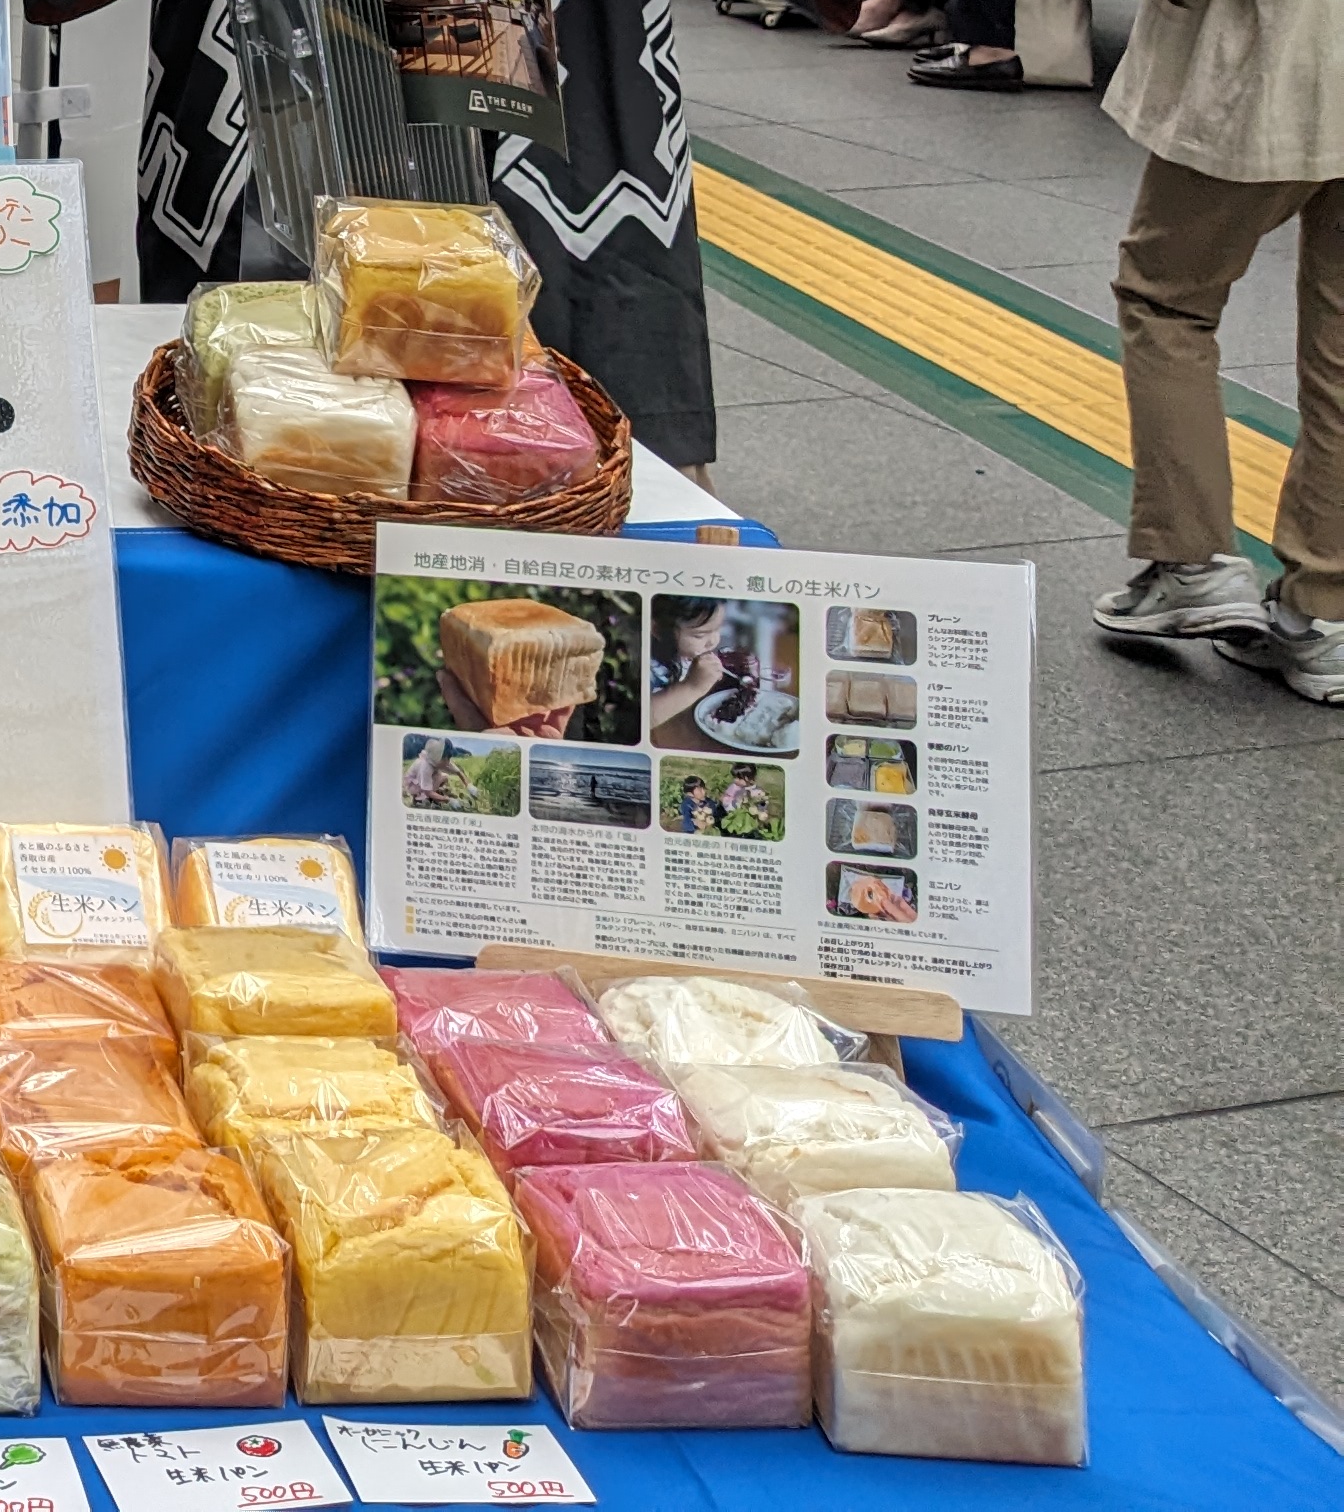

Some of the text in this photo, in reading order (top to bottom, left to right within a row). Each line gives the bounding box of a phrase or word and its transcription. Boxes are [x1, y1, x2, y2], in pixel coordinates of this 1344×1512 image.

[413, 550, 882, 600] 地産地消・自給自足の素材でつくった、癒しの生米パン
[18, 841, 91, 853] 水と風のふるさと
[213, 850, 286, 863] 水と風のふるさと
[19, 853, 56, 864] 香取市産
[20, 865, 92, 876] イセヒカリ100%
[217, 872, 288, 884] イセヒカリ100%
[50, 894, 139, 914] 生米パン
[248, 898, 337, 919] 生米パン
[361, 1434, 487, 1453] にんじん
[130, 1445, 202, 1464] トマト
[166, 1465, 270, 1486] 生米パン
[418, 1458, 521, 1477] 生米パン
[240, 1483, 317, 1503] 500円
[487, 1479, 565, 1497] 500円
